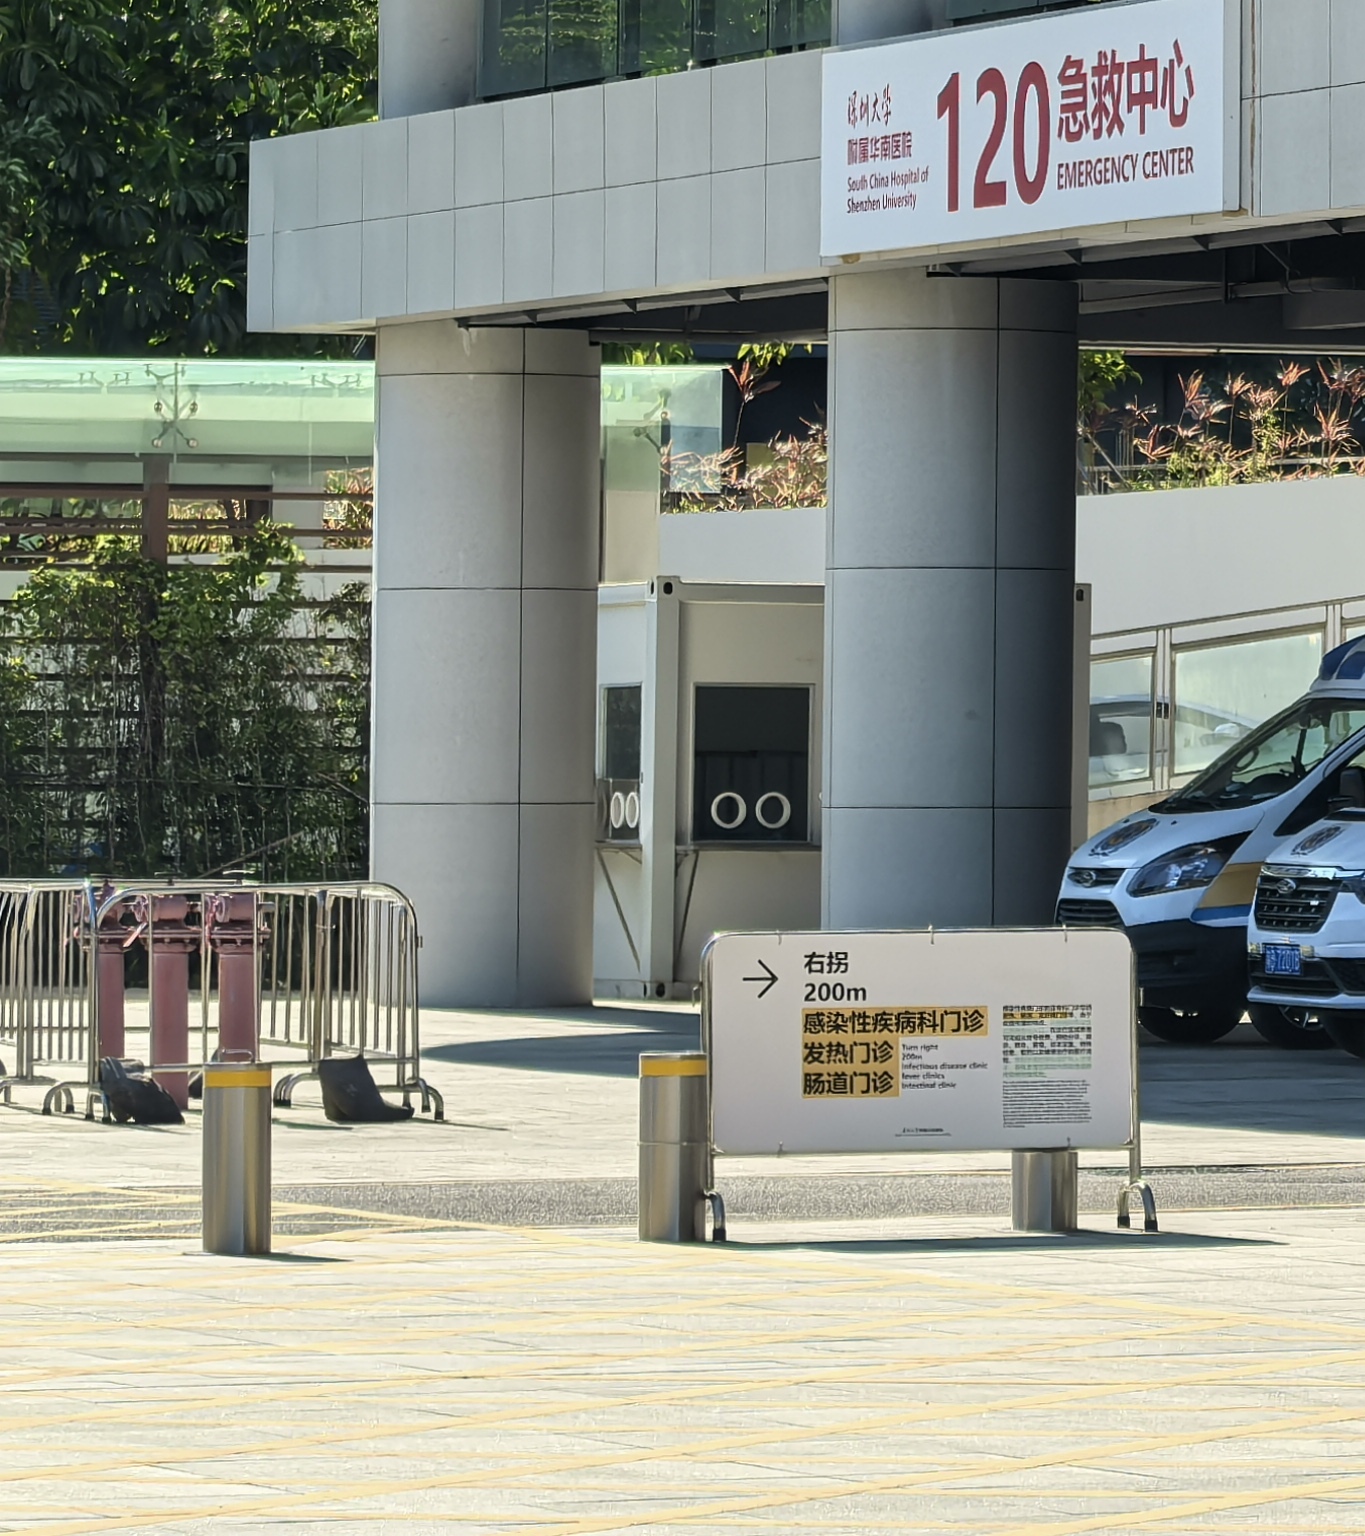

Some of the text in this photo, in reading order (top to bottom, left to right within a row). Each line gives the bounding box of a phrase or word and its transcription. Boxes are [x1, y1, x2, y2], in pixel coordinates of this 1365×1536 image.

[937, 38, 1195, 213] 120 急救中心
[847, 165, 930, 193] South China Hospital of
[1057, 146, 1194, 191] EMERGENCY CENTER
[847, 191, 917, 214] Shenzhen University
[803, 951, 849, 975] 右拐
[804, 982, 867, 1002] 200m
[803, 1009, 985, 1035] 感染性疾病科门诊
[803, 1040, 894, 1065] 发热门诊
[803, 1070, 894, 1095] 肠道门诊
